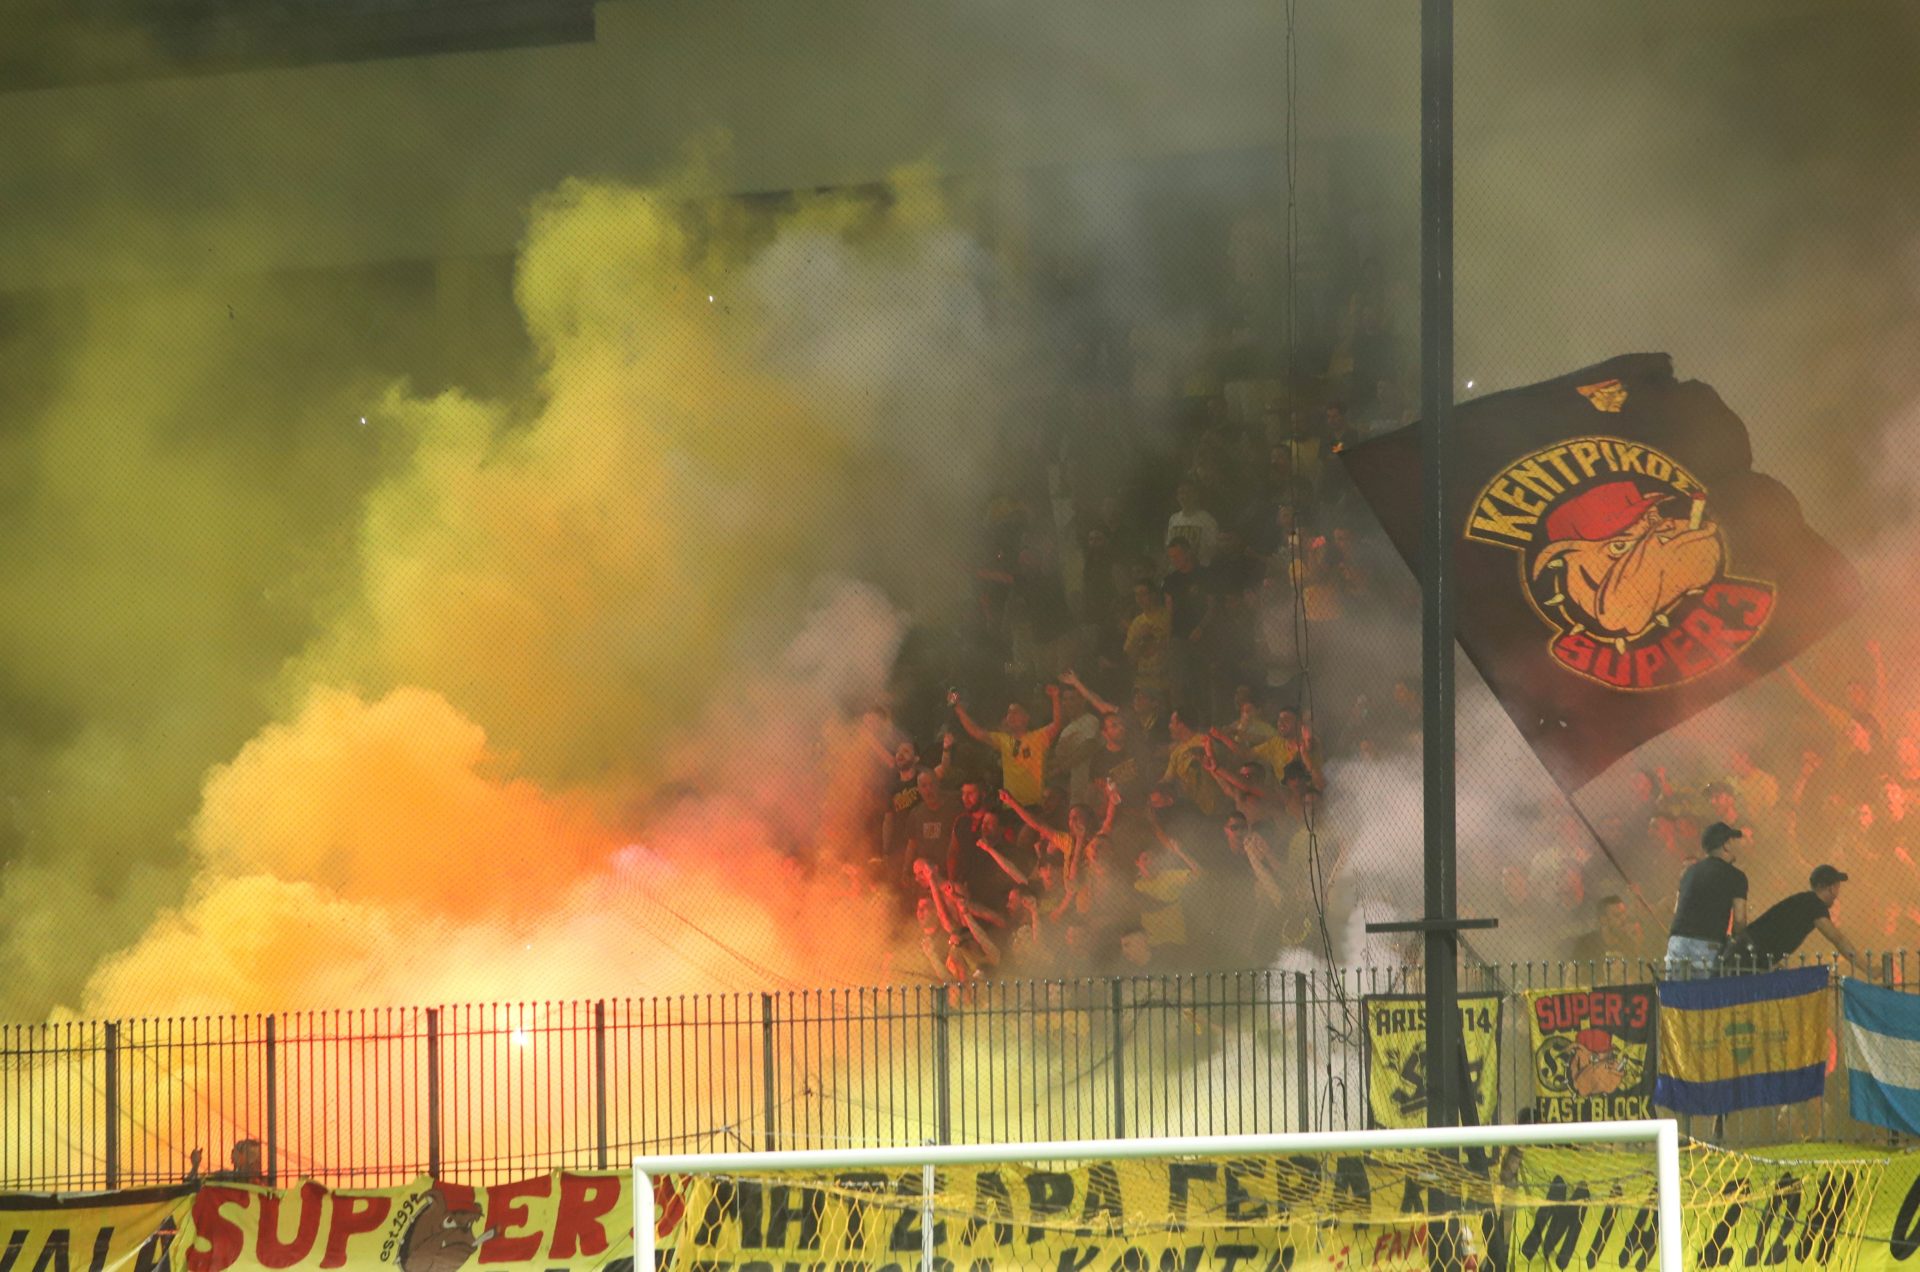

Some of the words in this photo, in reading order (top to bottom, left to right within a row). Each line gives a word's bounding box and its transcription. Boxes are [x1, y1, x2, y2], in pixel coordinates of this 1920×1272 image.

[1555, 608, 1756, 687] SUPER
[1703, 583, 1772, 627] 3
[1540, 1097, 1585, 1123] EAST
[1591, 1095, 1652, 1121] BLOCK
